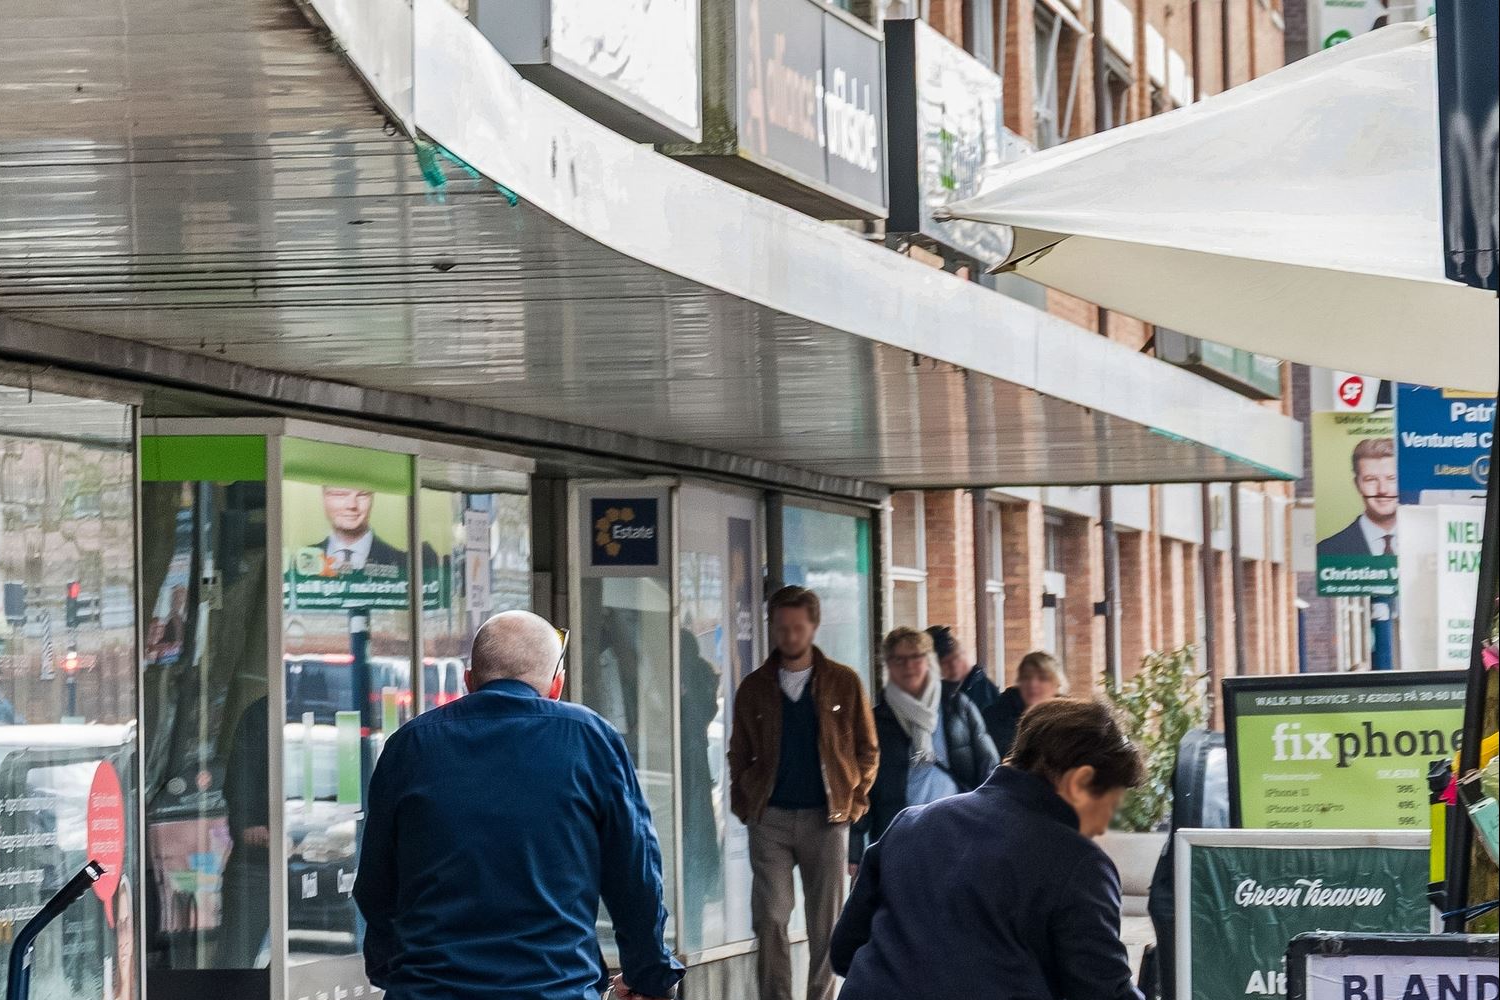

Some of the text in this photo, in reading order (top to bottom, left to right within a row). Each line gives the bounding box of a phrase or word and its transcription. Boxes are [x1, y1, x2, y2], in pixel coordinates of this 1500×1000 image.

[1401, 431, 1477, 449] Venturelli
[612, 524, 654, 539] Estate
[1320, 566, 1388, 581] Christian
[1235, 878, 1386, 908] Green heaven
